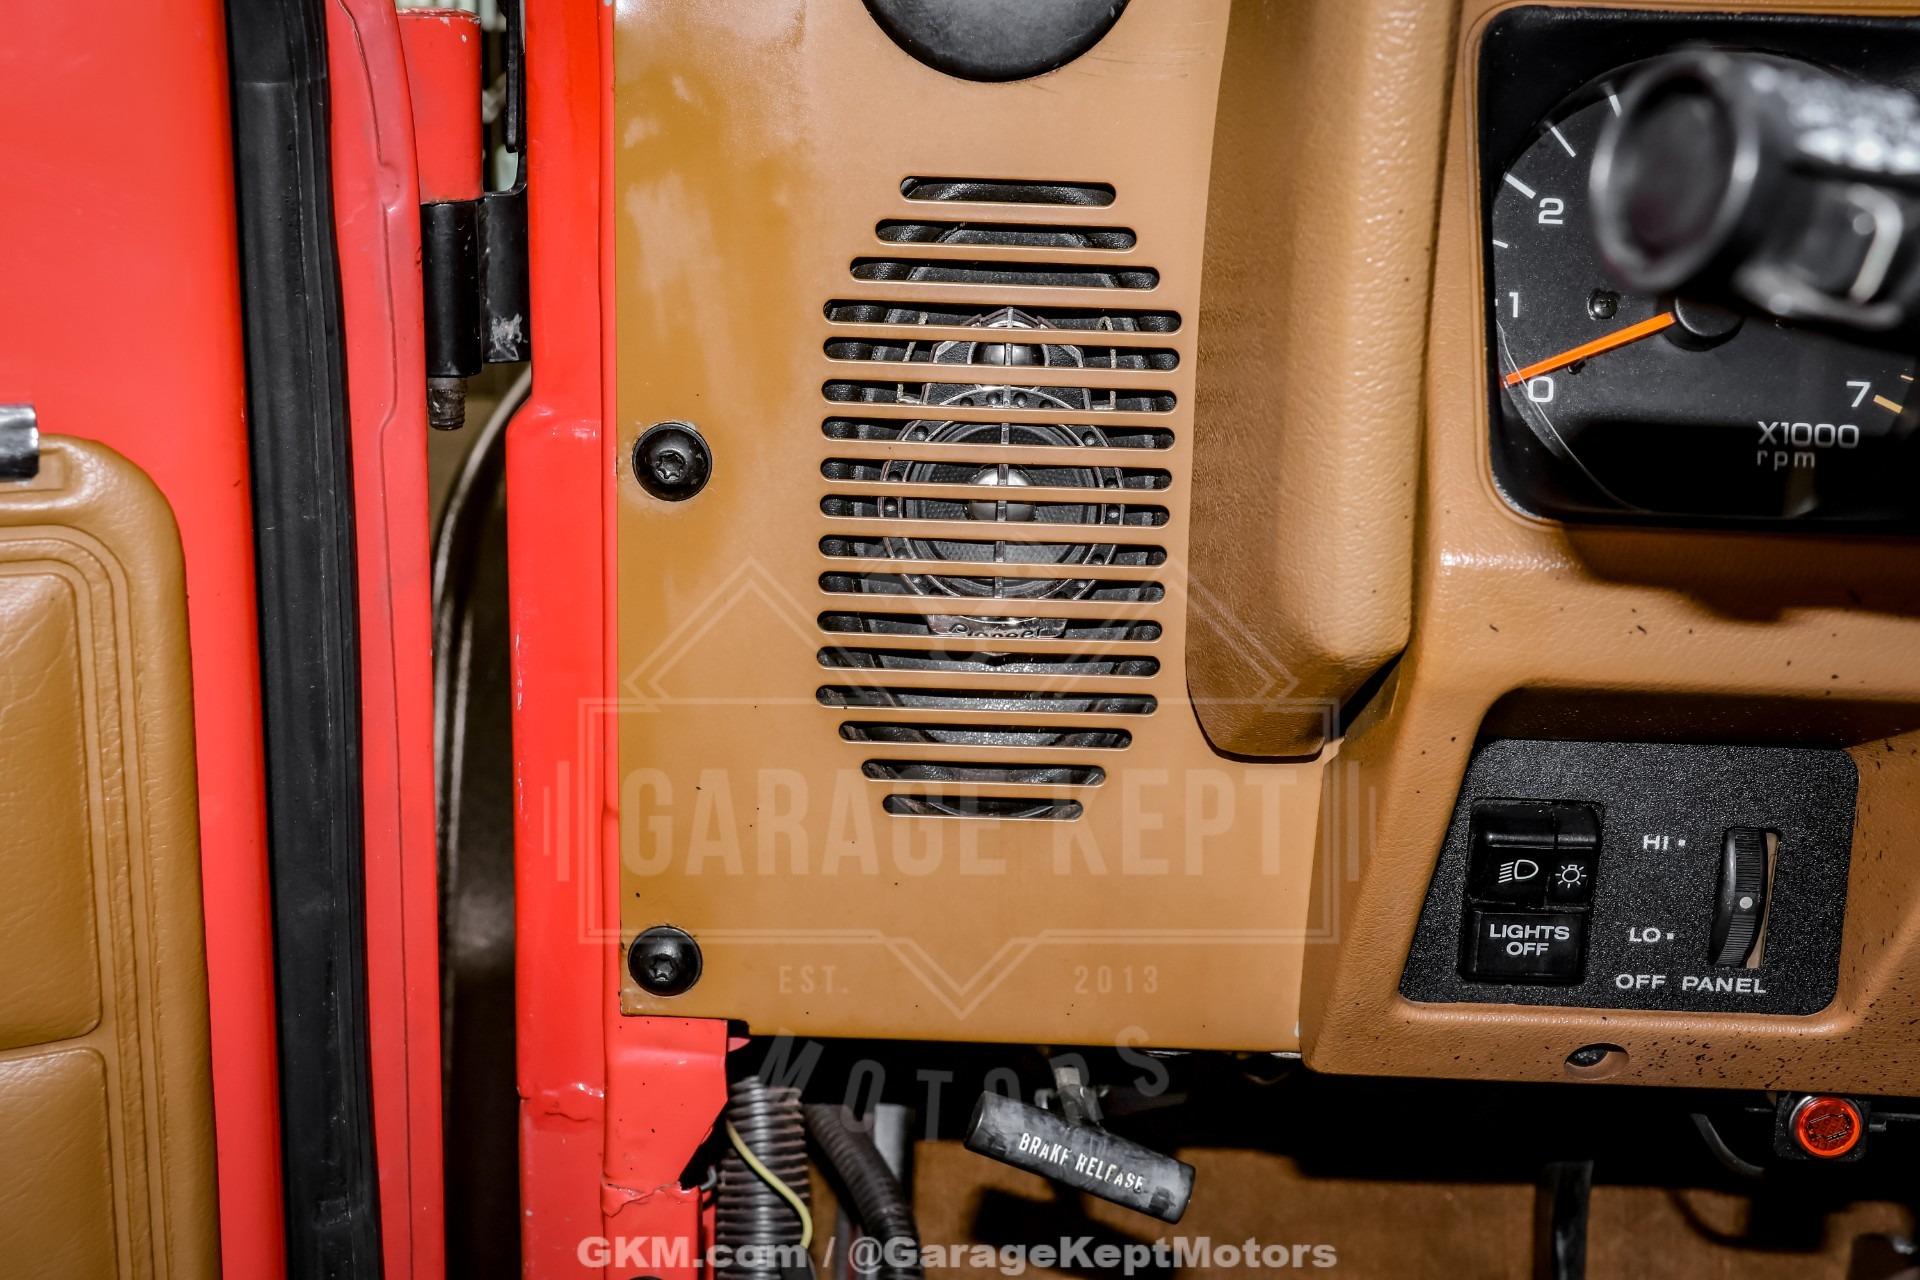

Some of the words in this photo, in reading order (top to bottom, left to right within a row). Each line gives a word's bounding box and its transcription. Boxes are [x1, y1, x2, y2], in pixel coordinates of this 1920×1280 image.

[1538, 198, 1564, 225] 2
[1508, 292, 1519, 318] 1
[1527, 376, 1554, 403] 0
[1845, 381, 1871, 408] 7
[1757, 421, 1860, 449] X1000
[1757, 449, 1816, 470] rpm
[1642, 834, 1670, 851] HI
[1488, 923, 1571, 941] LIGHTS
[1628, 927, 1662, 944] LO
[1505, 941, 1550, 957] OFF
[1615, 974, 1666, 991] OFF
[1681, 975, 1767, 995] PANEL
